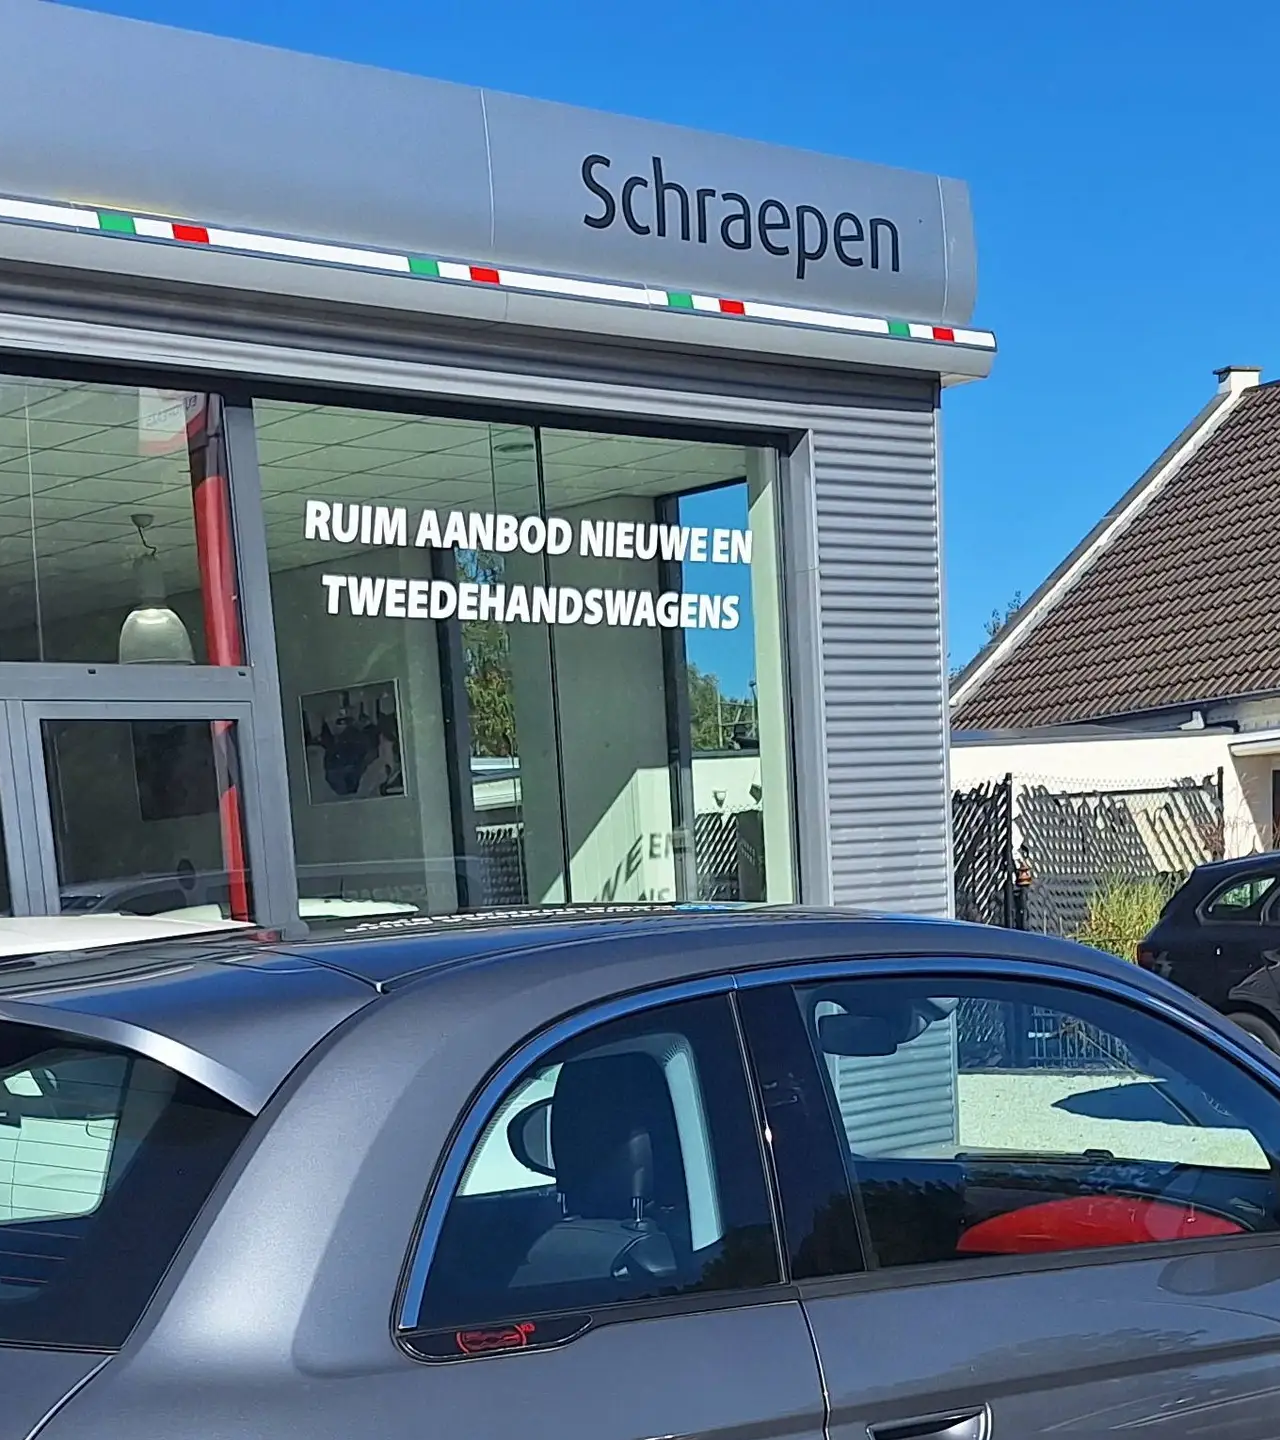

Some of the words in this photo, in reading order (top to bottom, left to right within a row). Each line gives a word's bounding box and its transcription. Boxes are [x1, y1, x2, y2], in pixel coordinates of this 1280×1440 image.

[581, 153, 900, 280] Schraepen
[304, 499, 408, 547] RUIM
[414, 508, 573, 556] AANBOD
[579, 519, 708, 563] NIEUWE
[713, 528, 753, 565] EN
[322, 574, 740, 631] TWEEDEHANDSWAGENS
